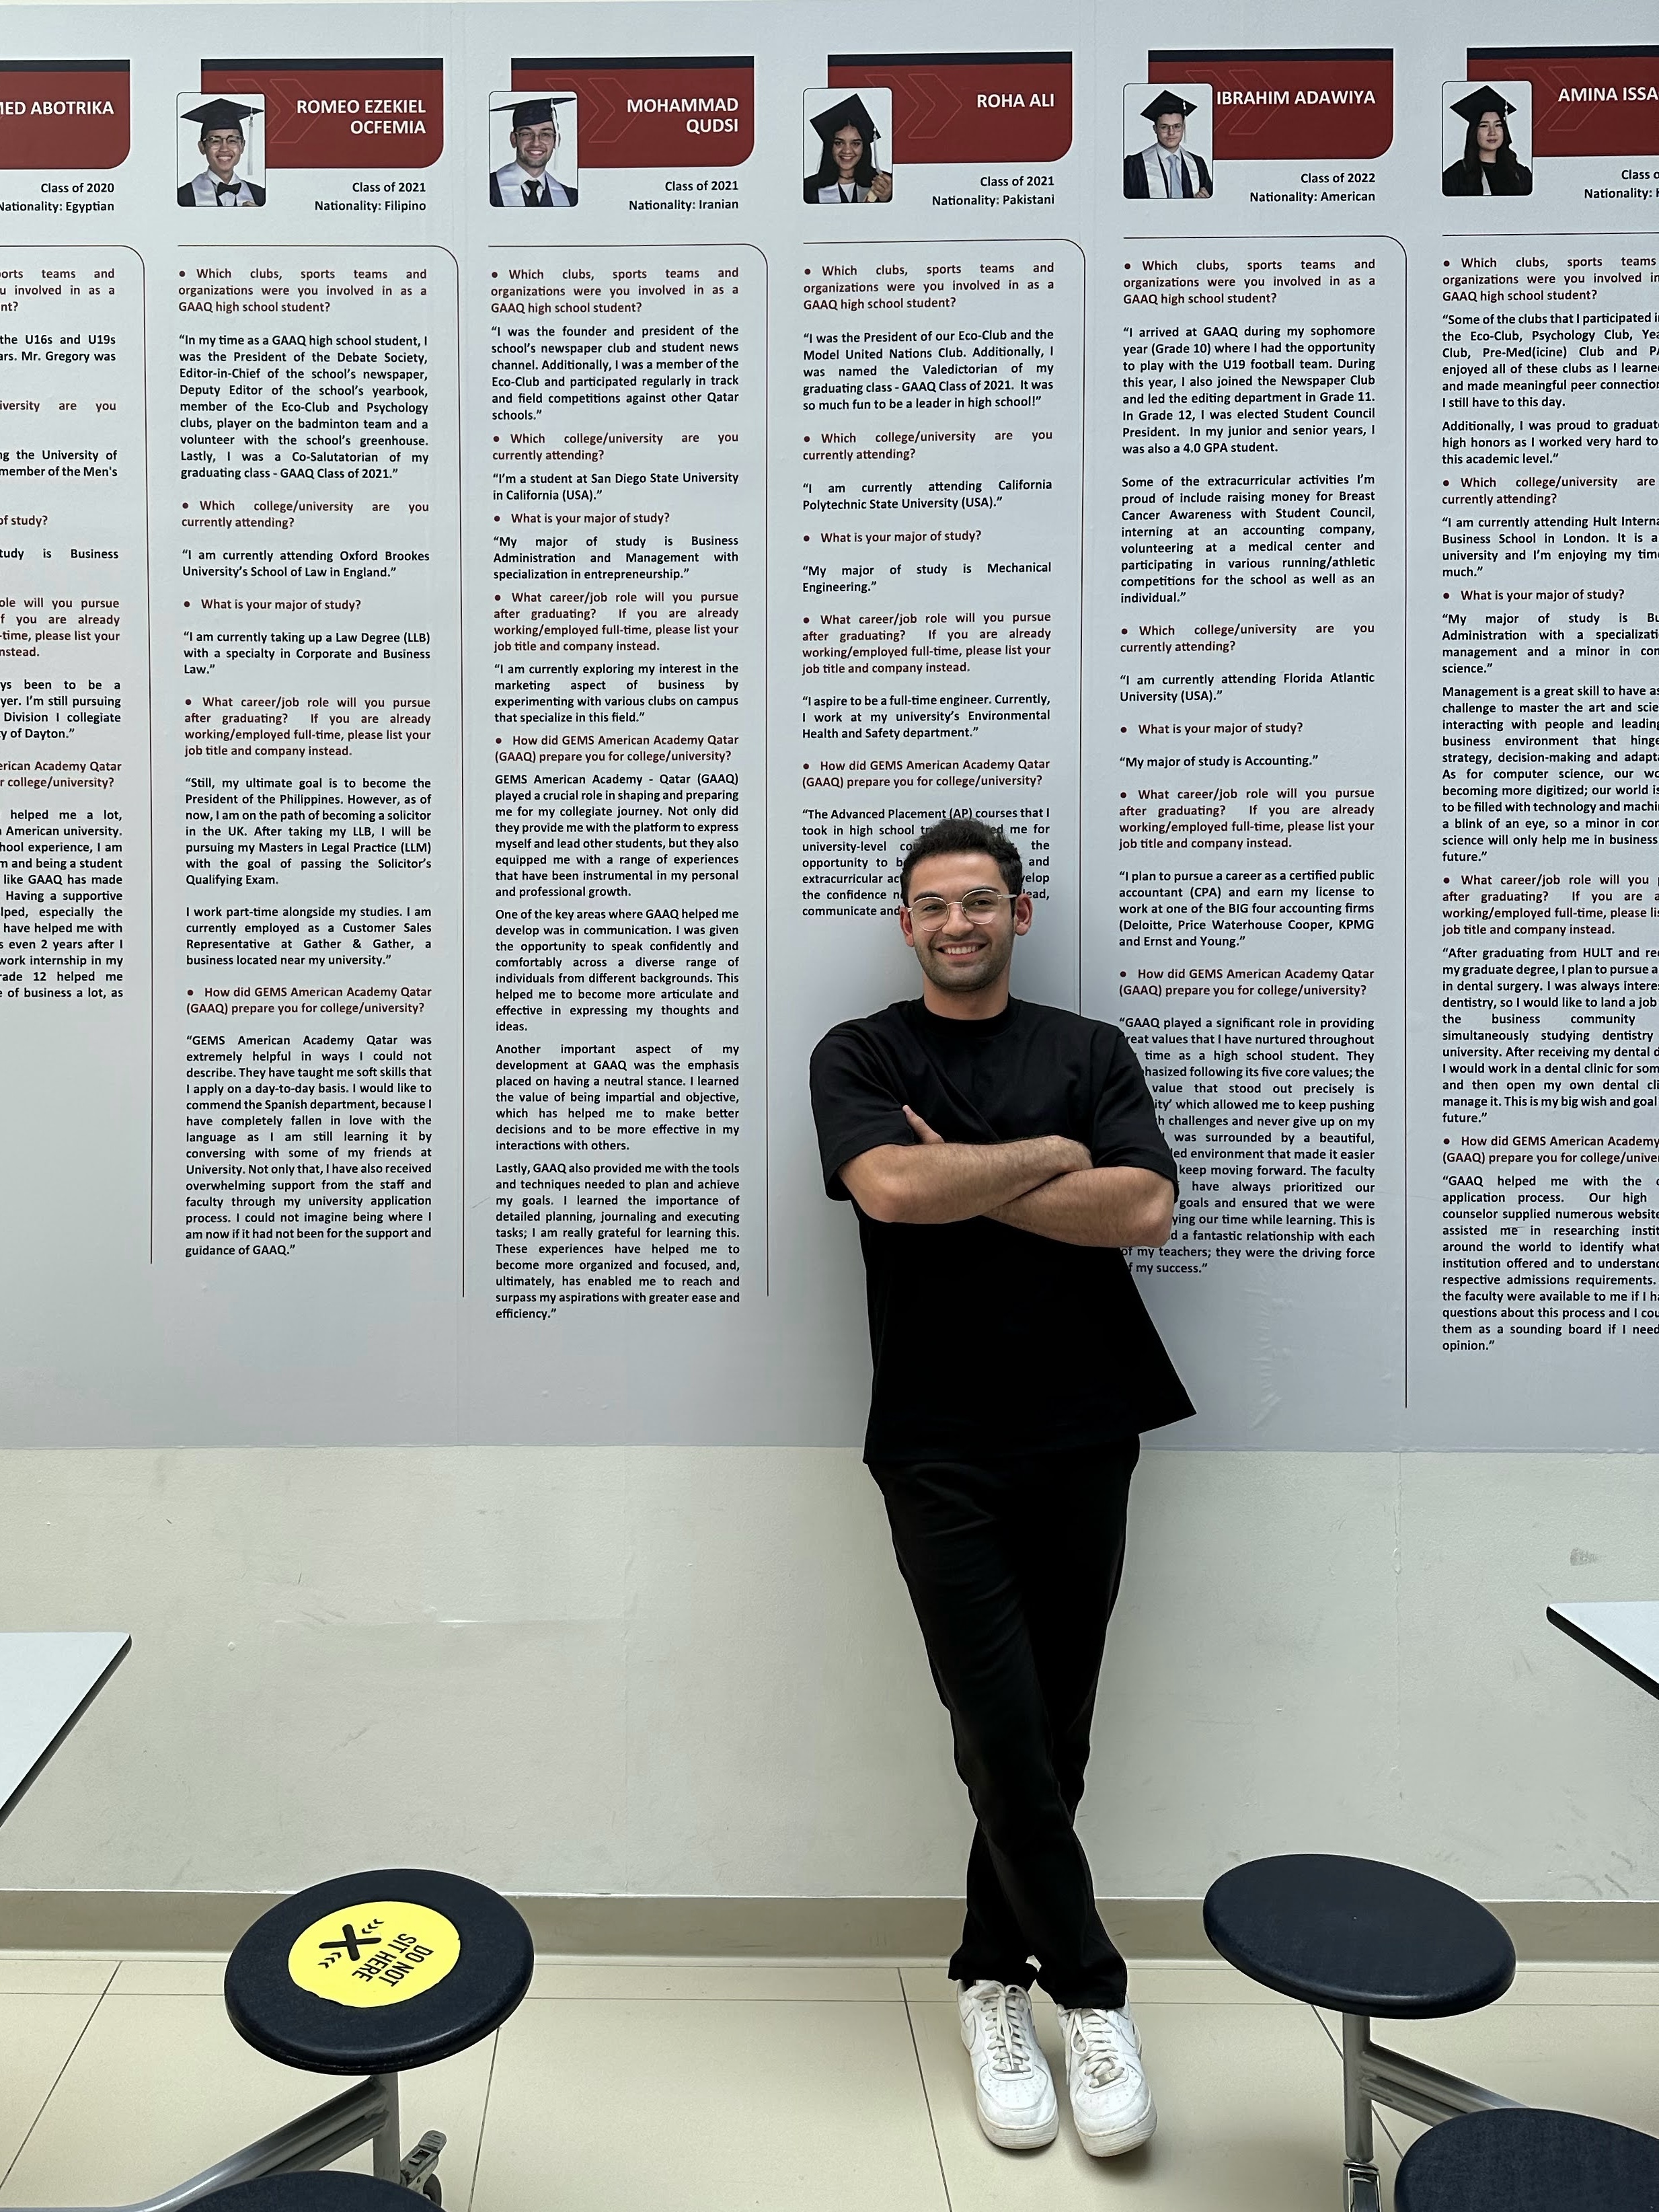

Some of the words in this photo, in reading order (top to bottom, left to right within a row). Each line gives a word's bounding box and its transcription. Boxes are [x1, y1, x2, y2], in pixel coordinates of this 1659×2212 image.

[977, 93, 1026, 108] ROHA
[1029, 93, 1054, 108] ALI
[1216, 89, 1289, 105] IBRAHIM
[1294, 90, 1376, 105] ADAWIYA
[1557, 87, 1619, 102] AMINA
[30, 101, 114, 115] ABOTRIKA
[297, 100, 360, 114] ROMEO
[364, 100, 426, 114] EZEKIEL
[627, 98, 738, 113] MOHAMMAD
[350, 120, 426, 135] OCFEMIA
[686, 118, 738, 135] QUDSI
[980, 176, 1009, 187] Class
[1011, 175, 1025, 186] of
[1026, 176, 1055, 186] 2021
[1301, 172, 1329, 184] Class
[1332, 172, 1345, 184] of
[1347, 172, 1376, 183] 2022
[1621, 169, 1650, 180] Class
[40, 182, 69, 193] Class
[71, 182, 85, 193] of
[86, 182, 115, 193] 2020
[352, 181, 381, 192] Class
[383, 181, 396, 192] of
[398, 182, 426, 192] 2021
[664, 180, 693, 192] Class
[696, 180, 709, 191] of
[711, 180, 739, 191] 2021
[1249, 191, 1317, 204] Nationality:
[1320, 190, 1375, 202] American
[1584, 187, 1652, 200] Nationality:
[65, 200, 114, 214] Egyptian
[315, 200, 381, 213] Nationality:
[385, 200, 426, 213] Filipino
[629, 199, 696, 213] Nationality:
[699, 198, 739, 210] Iranian
[932, 194, 999, 208] Nationality:
[1003, 194, 1054, 205] Pakistani
[821, 264, 857, 276] Which
[876, 264, 908, 277] clubs,
[926, 264, 962, 277] sports
[979, 264, 1015, 274] teams
[1033, 262, 1054, 273] and
[803, 282, 879, 296] organizations
[886, 283, 915, 292] were
[923, 282, 944, 294] you
[952, 279, 1001, 291] involved
[1008, 279, 1019, 290] in
[1027, 281, 1040, 290] as
[1047, 281, 1054, 289] a
[1123, 294, 1159, 305] GAAQ
[1161, 293, 1185, 306] high
[1188, 293, 1224, 304] school
[1227, 292, 1277, 303] student?
[0, 334, 18, 345] the
[25, 334, 53, 345] U16s
[59, 334, 81, 345] and
[88, 334, 116, 345] U19s
[491, 342, 536, 354] school’s
[541, 345, 603, 356] newspaper
[607, 342, 631, 354] club
[635, 342, 656, 353] and
[661, 341, 705, 353] student
[709, 344, 739, 352] news
[804, 349, 839, 360] Model
[845, 348, 883, 360] United
[889, 348, 933, 359] Nations
[937, 346, 966, 358] Club.
[972, 345, 1044, 359] Additionally,
[1050, 346, 1054, 356] I
[1122, 446, 1145, 455] was
[1147, 443, 1171, 454] also
[1173, 445, 1180, 453] a
[1183, 443, 1201, 453] 4.0
[1204, 443, 1229, 453] GPA
[1231, 441, 1278, 453] student.
[1442, 453, 1463, 465] this
[1465, 453, 1520, 464] academic
[1522, 452, 1559, 464] level.”
[803, 498, 867, 512] Polytechnic
[869, 498, 899, 509] State
[902, 497, 959, 510] University
[961, 496, 1003, 510] (USA).”
[181, 516, 233, 530] currently
[235, 517, 295, 530] attending?
[493, 568, 568, 582] specialization
[570, 568, 581, 580] in
[584, 568, 689, 582] entrepreneurship.”
[802, 580, 877, 595] Engineering.”
[3, 711, 48, 722] Division
[56, 712, 60, 722] I
[67, 712, 122, 725] collegiate
[802, 728, 839, 739] Health
[841, 727, 862, 738] and
[865, 727, 900, 740] Safety
[902, 726, 979, 740] department.”
[1118, 838, 1138, 851] job
[1140, 837, 1163, 849] title
[1166, 837, 1188, 849] and
[1191, 840, 1244, 851] company
[1246, 837, 1293, 848] instead.
[3, 874, 24, 884] like
[28, 874, 63, 886] GAAQ
[67, 874, 87, 884] has
[91, 874, 123, 884] made
[186, 874, 243, 887] Qualifying
[245, 874, 279, 885] Exam.
[495, 886, 516, 897] and
[519, 886, 586, 899] professional
[588, 886, 631, 899] growth.
[802, 905, 878, 916] communicate
[880, 905, 900, 916] and
[1118, 936, 1141, 946] and
[1144, 936, 1173, 946] Ernst
[1175, 936, 1197, 946] and
[1200, 935, 1245, 948] Young.”
[1118, 1017, 1161, 1030] “GAAQ
[1163, 1017, 1202, 1030] played
[1205, 1020, 1212, 1028] a
[1216, 1017, 1275, 1030] significant
[1278, 1017, 1301, 1028] role
[1305, 1017, 1316, 1028] in
[1320, 1017, 1375, 1030] providing
[186, 1034, 225, 1046] “GEMS
[237, 1034, 291, 1045] American
[303, 1034, 354, 1047] Academy
[366, 1034, 398, 1046] Qatar
[410, 1036, 432, 1045] was
[1192, 1180, 1219, 1192] have
[1231, 1180, 1271, 1194] always
[1284, 1181, 1342, 1194] prioritized
[1355, 1184, 1375, 1193] our
[185, 1245, 235, 1258] guidance
[238, 1244, 251, 1255] of
[252, 1244, 296, 1256] GAAQ.”
[495, 1294, 537, 1305] surpass
[539, 1294, 557, 1305] my
[559, 1291, 619, 1305] aspirations
[621, 1291, 646, 1303] with
[648, 1293, 689, 1305] greater
[691, 1294, 717, 1303] ease
[719, 1292, 740, 1303] and
[496, 1307, 557, 1321] efficiency.”
[1442, 1339, 1495, 1353] opinion.”
[387, 1933, 417, 1954] SIT
[404, 1944, 434, 1963] DO
[351, 1950, 397, 1982] HERE
[378, 1961, 415, 1987] NOT
